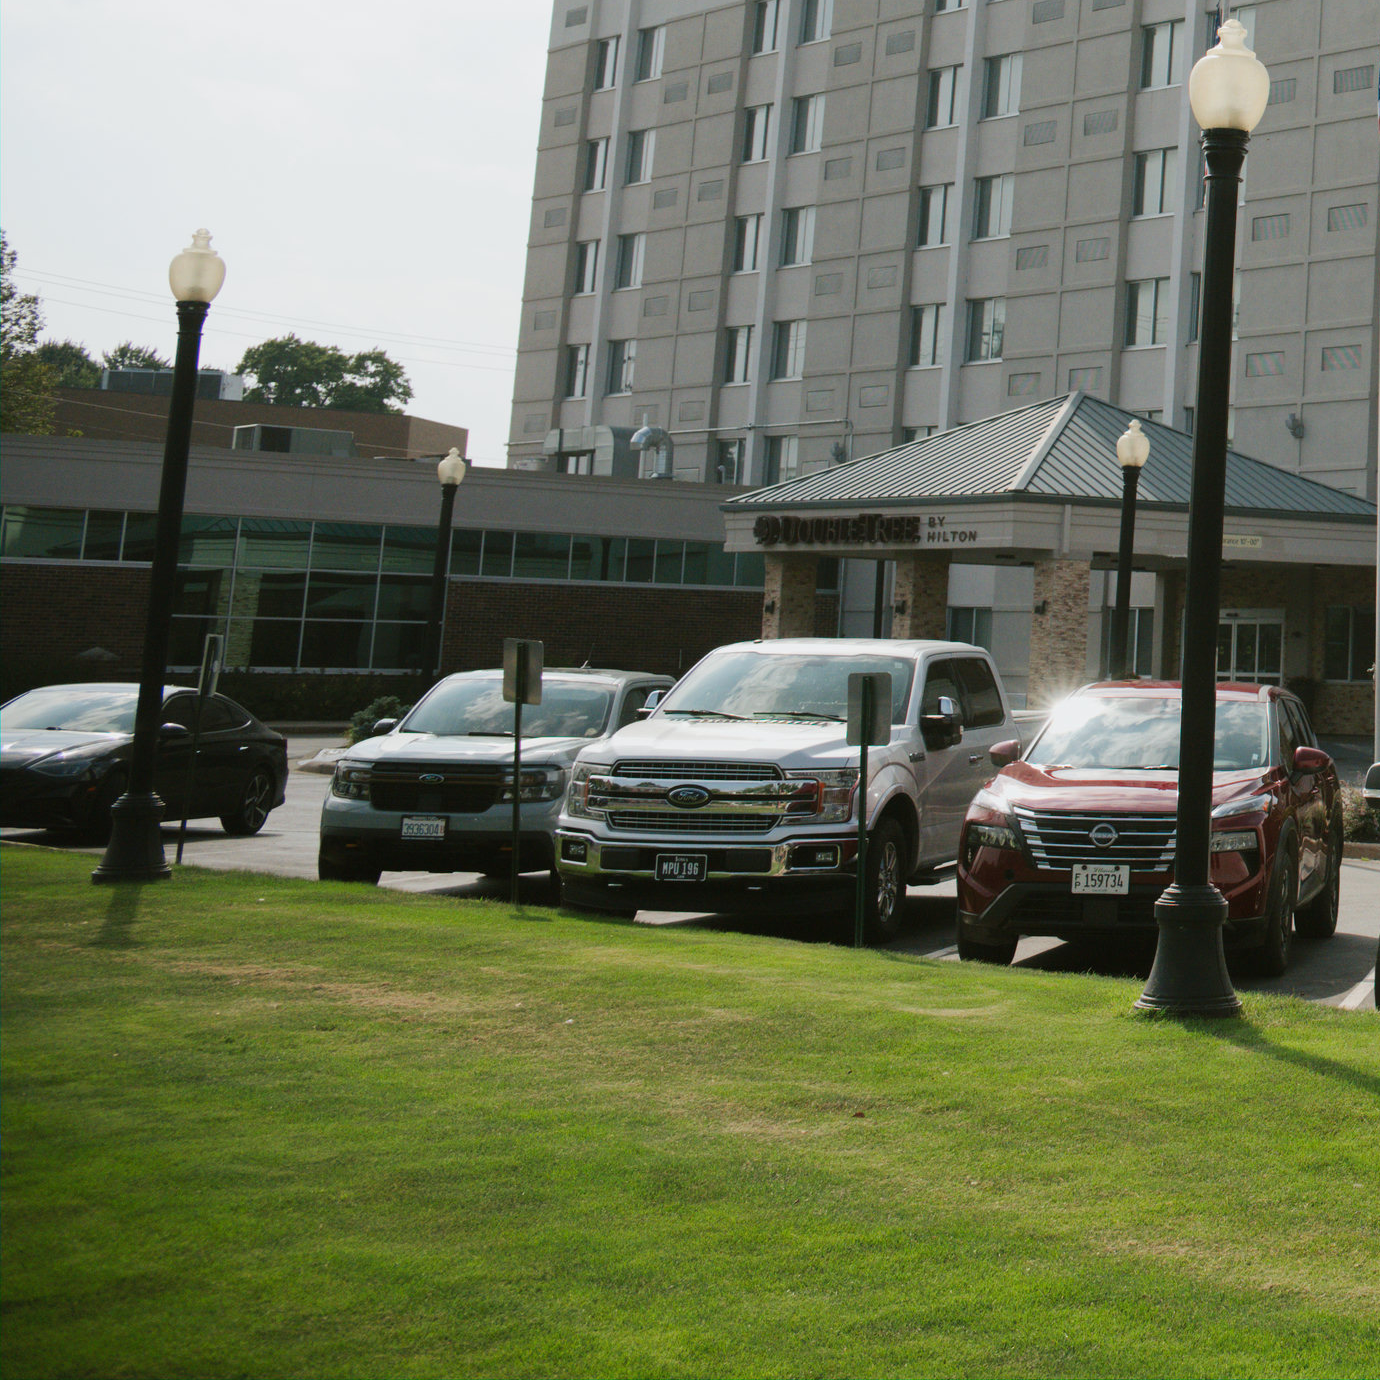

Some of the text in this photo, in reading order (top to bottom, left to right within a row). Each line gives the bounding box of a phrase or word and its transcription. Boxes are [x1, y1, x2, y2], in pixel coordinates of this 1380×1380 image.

[928, 516, 946, 528] BY
[927, 530, 978, 543] HILTON
[662, 862, 699, 875] MPU 196
[1084, 873, 1123, 888] 159734
